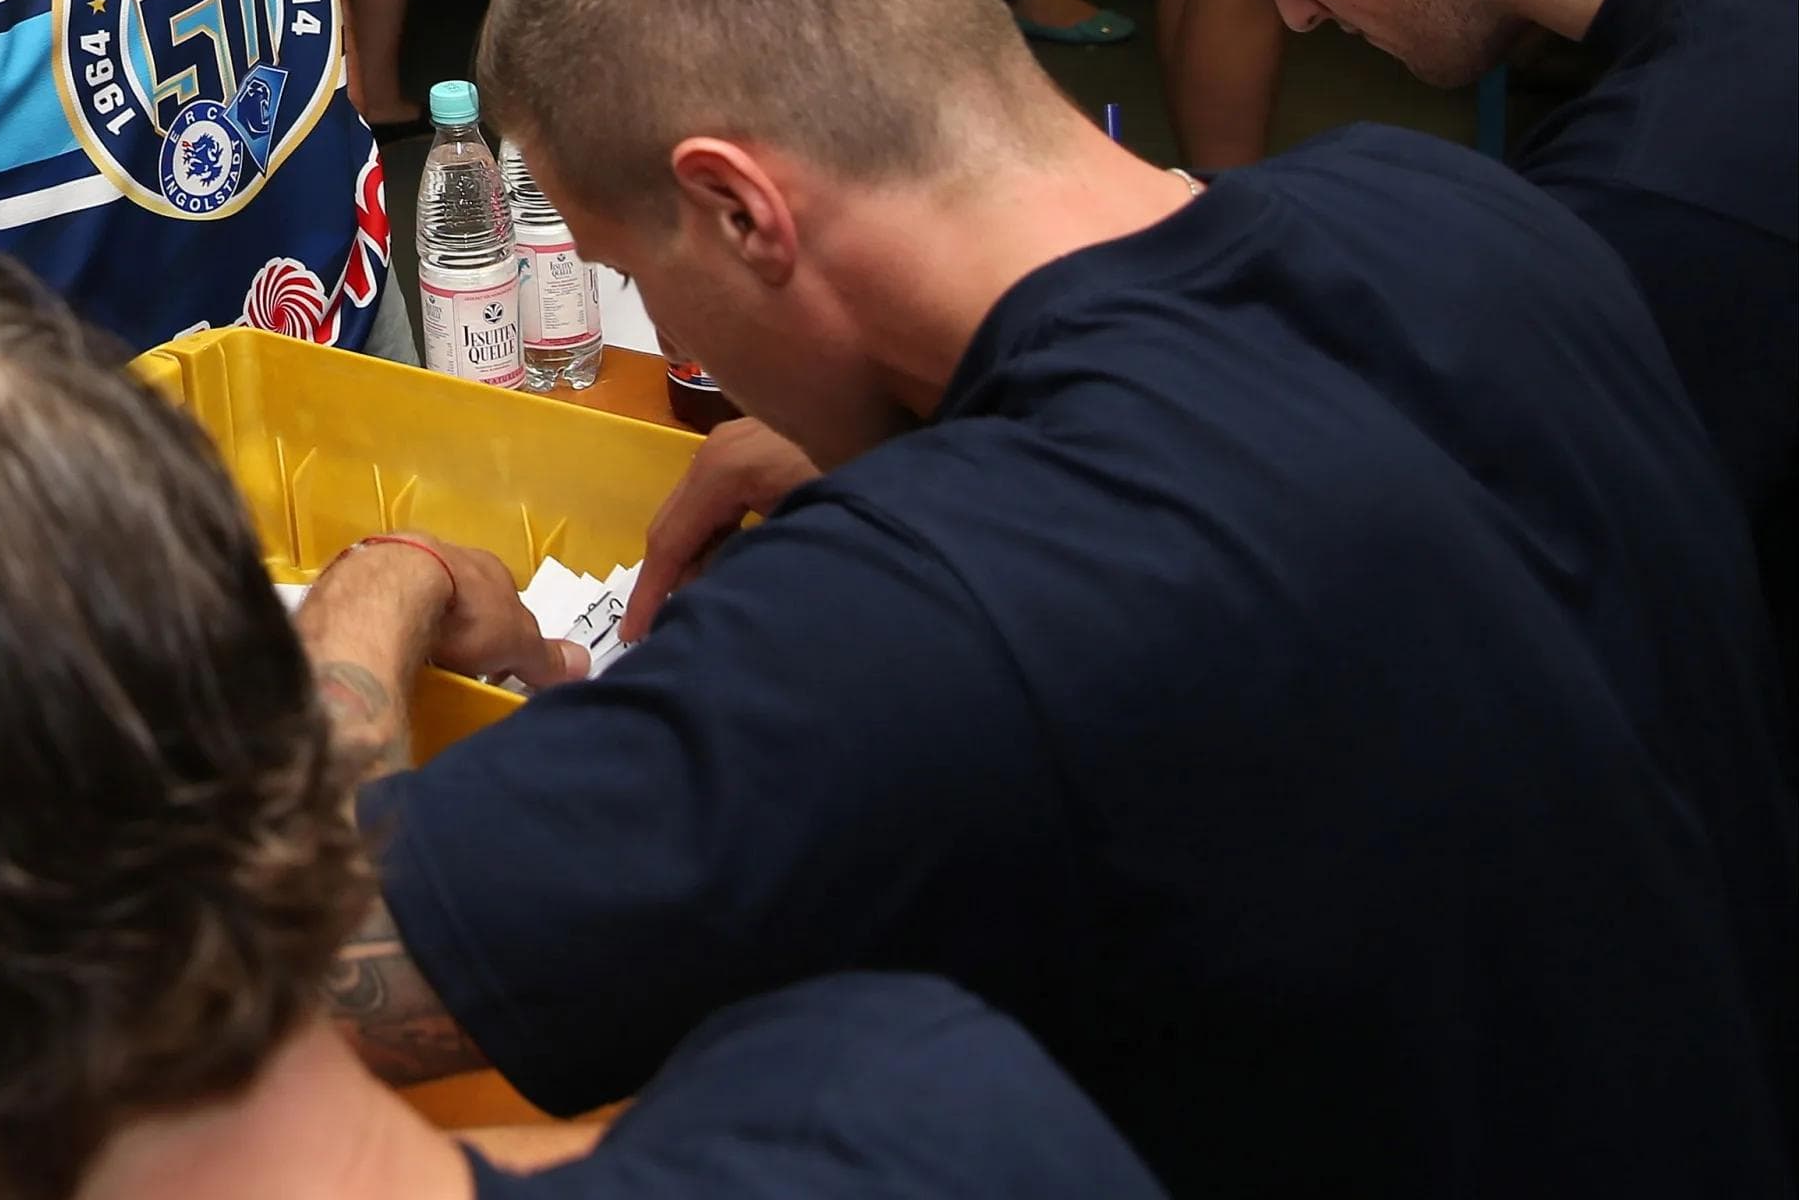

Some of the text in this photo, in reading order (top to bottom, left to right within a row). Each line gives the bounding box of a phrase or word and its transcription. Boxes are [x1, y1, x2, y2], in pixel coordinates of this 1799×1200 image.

[80, 30, 137, 137] 1964
[164, 140, 243, 212] INGOLSTADT
[468, 339, 516, 365] QUELLE
